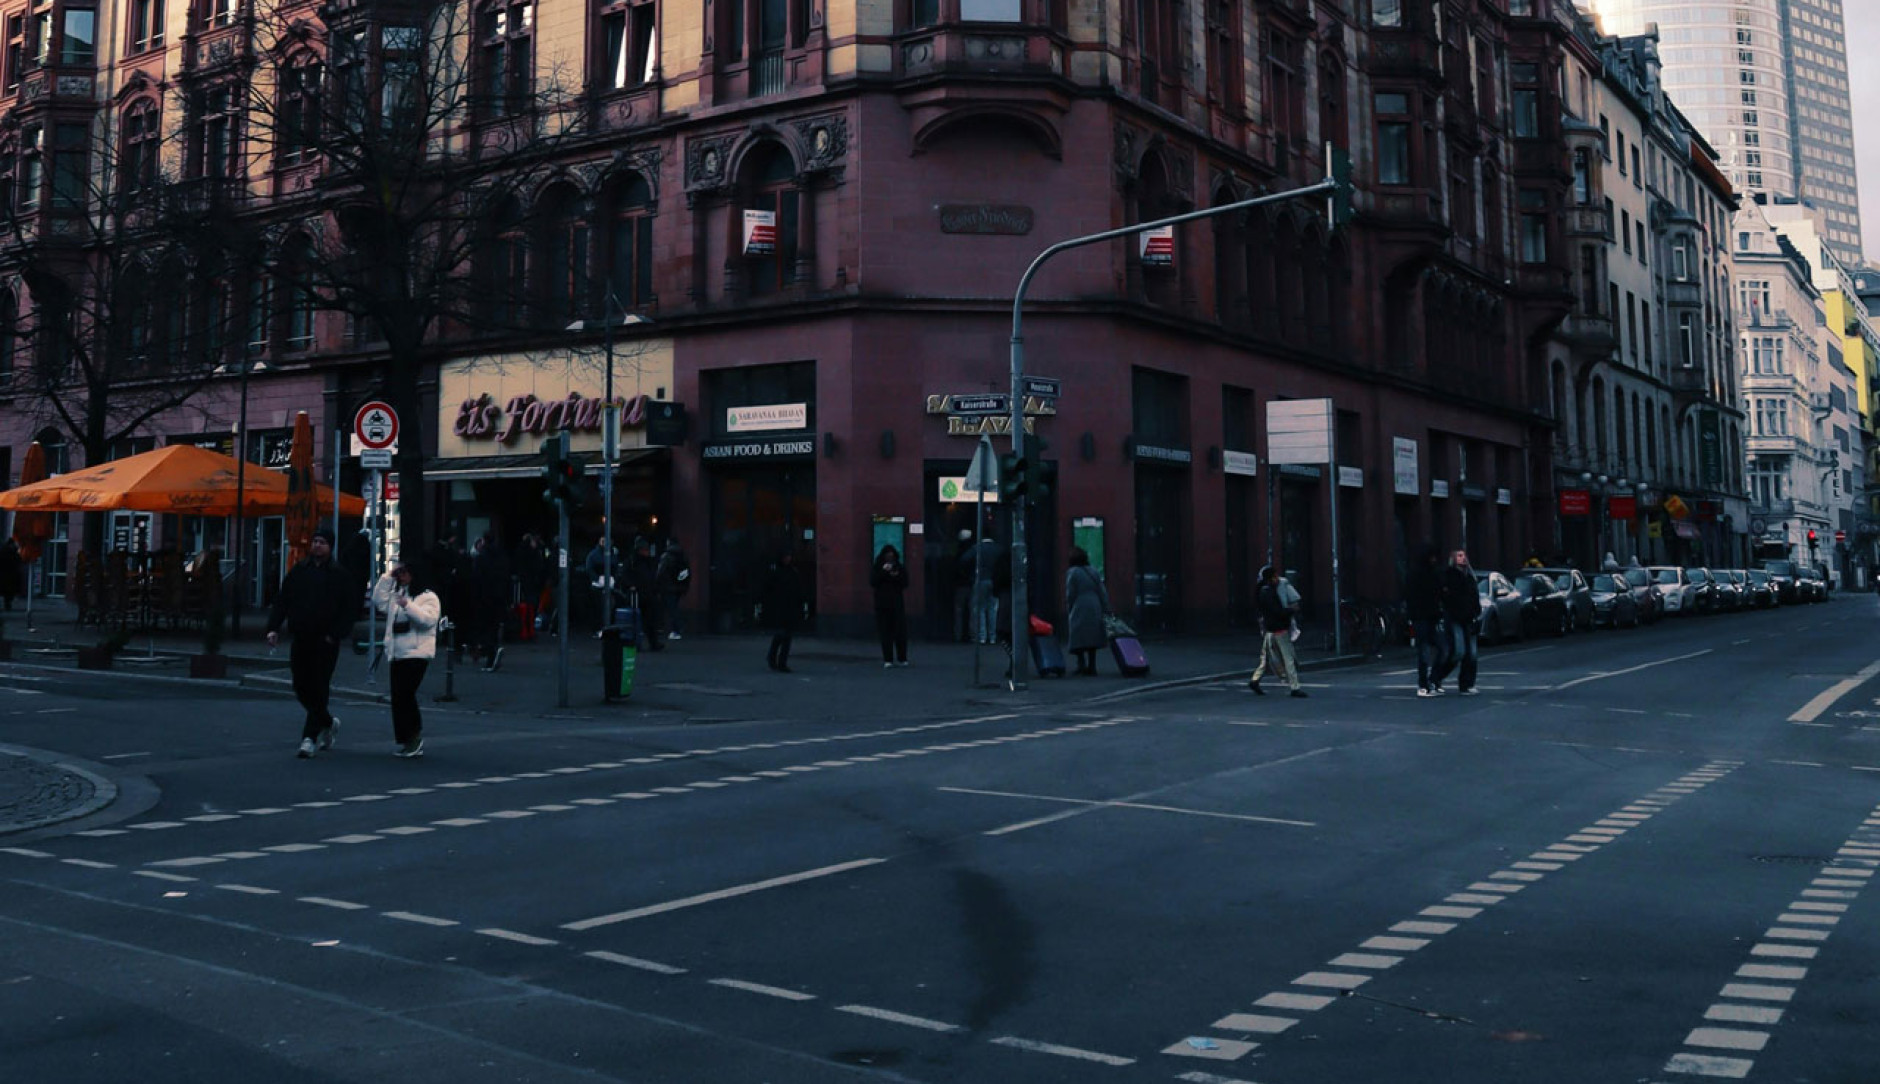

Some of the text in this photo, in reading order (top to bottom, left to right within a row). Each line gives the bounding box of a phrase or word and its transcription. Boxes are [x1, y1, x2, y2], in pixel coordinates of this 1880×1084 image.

[703, 441, 812, 457] ASIAN FOOD & DRINKS
